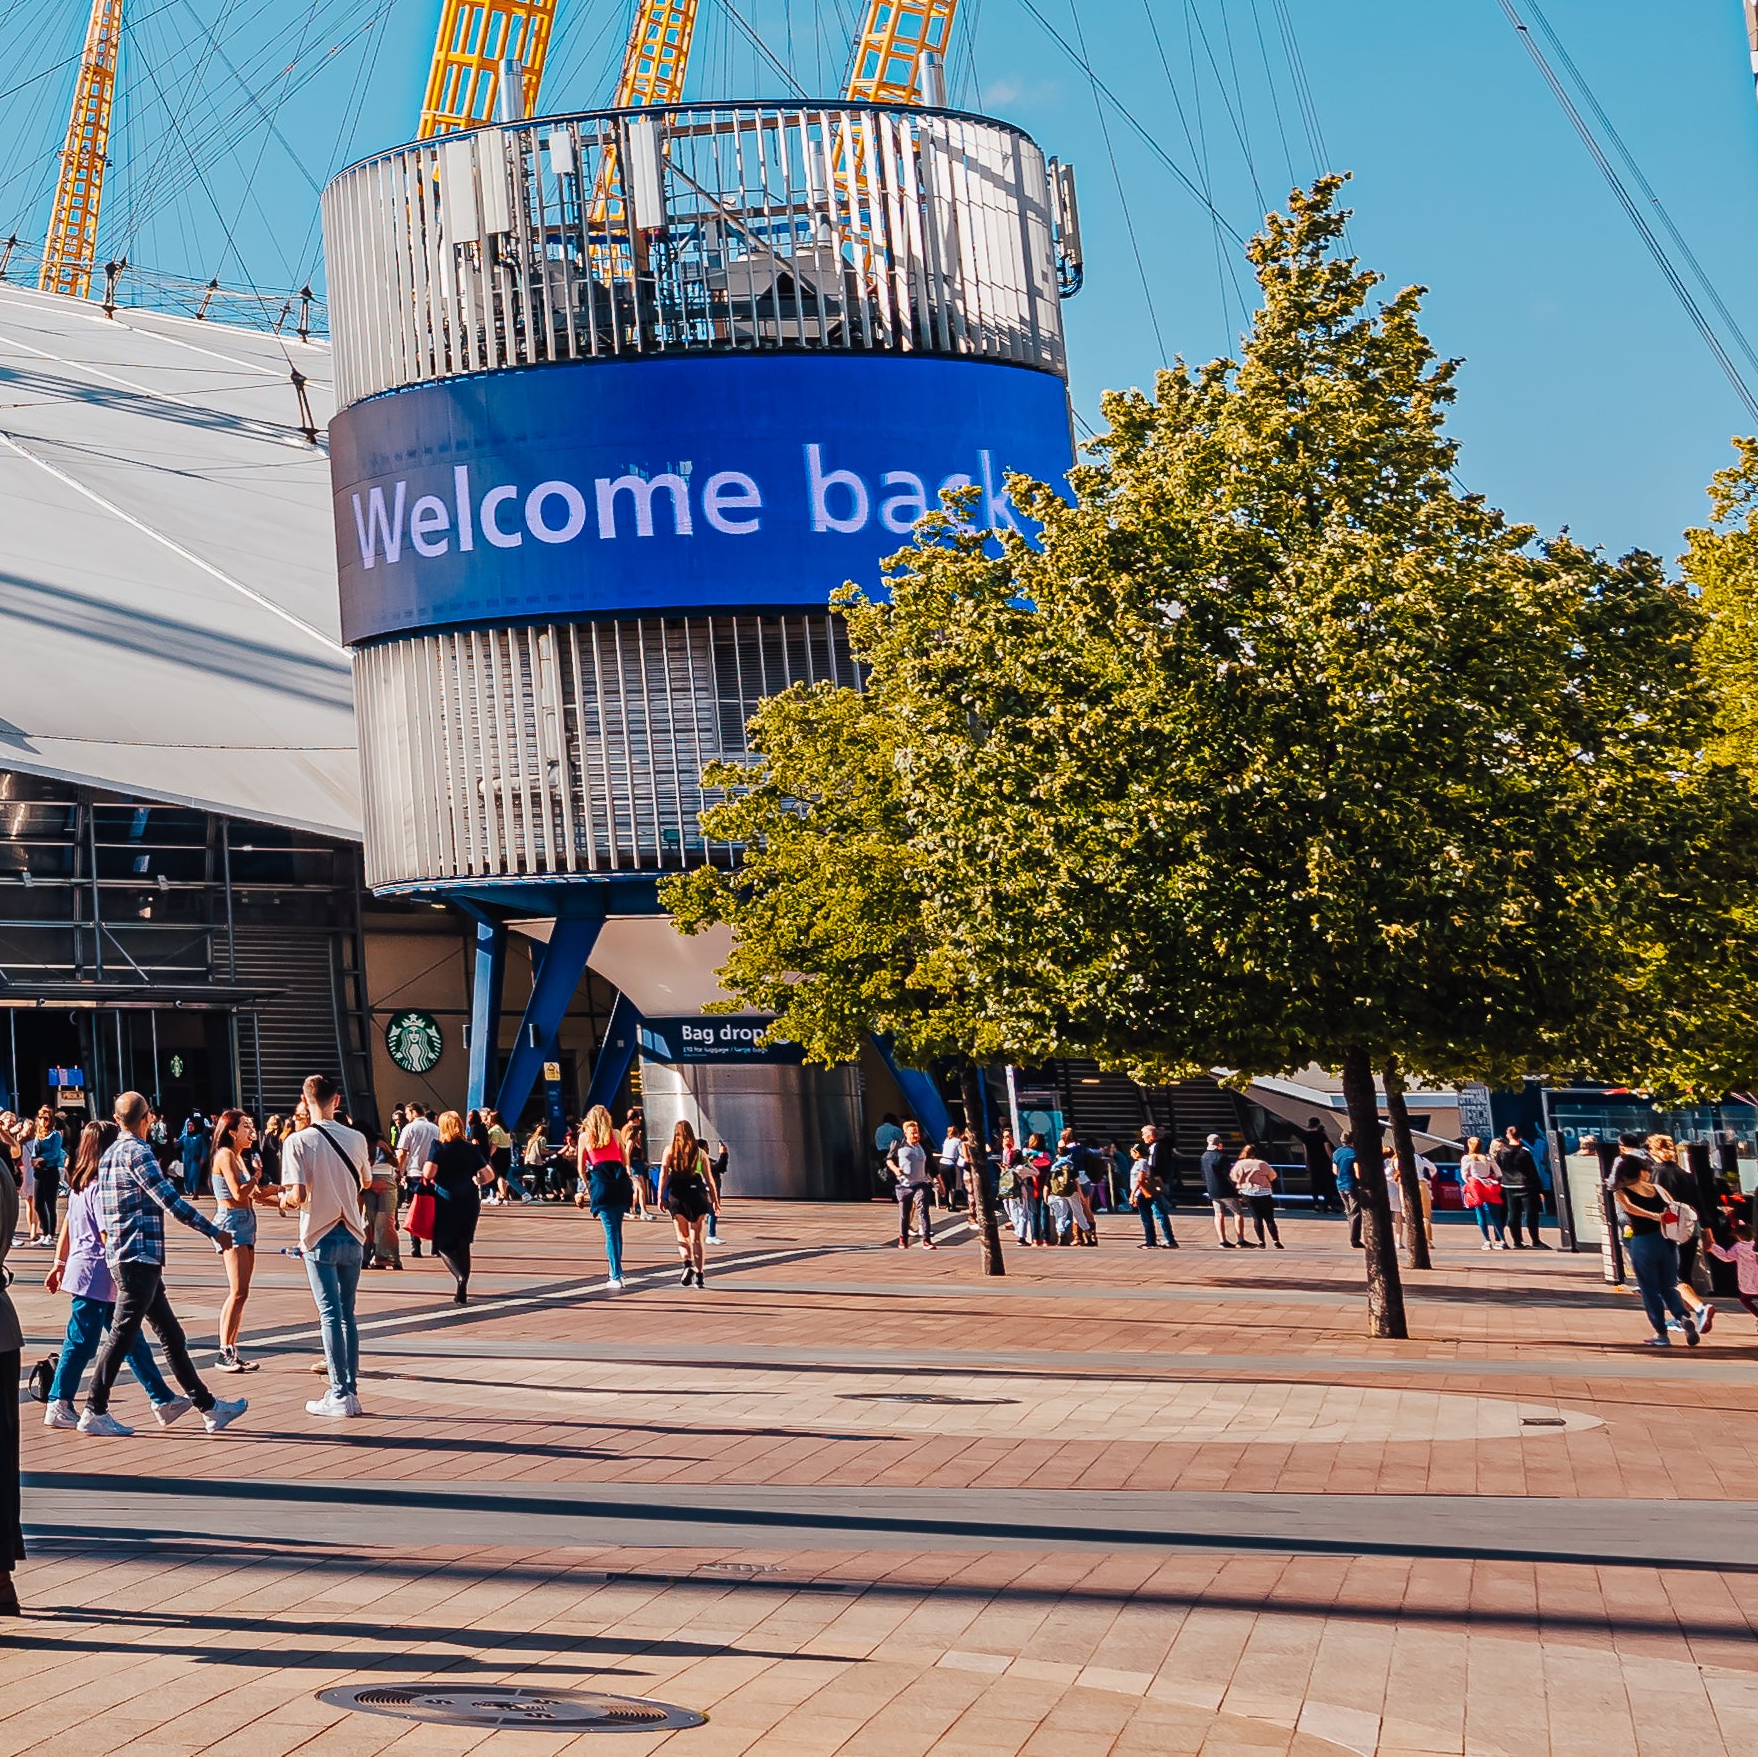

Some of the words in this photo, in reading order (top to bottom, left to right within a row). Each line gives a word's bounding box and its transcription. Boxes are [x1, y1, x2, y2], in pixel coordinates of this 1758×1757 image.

[352, 463, 762, 570] Welcome
[681, 1025, 715, 1045] Bag
[704, 1046, 729, 1054] luggage
